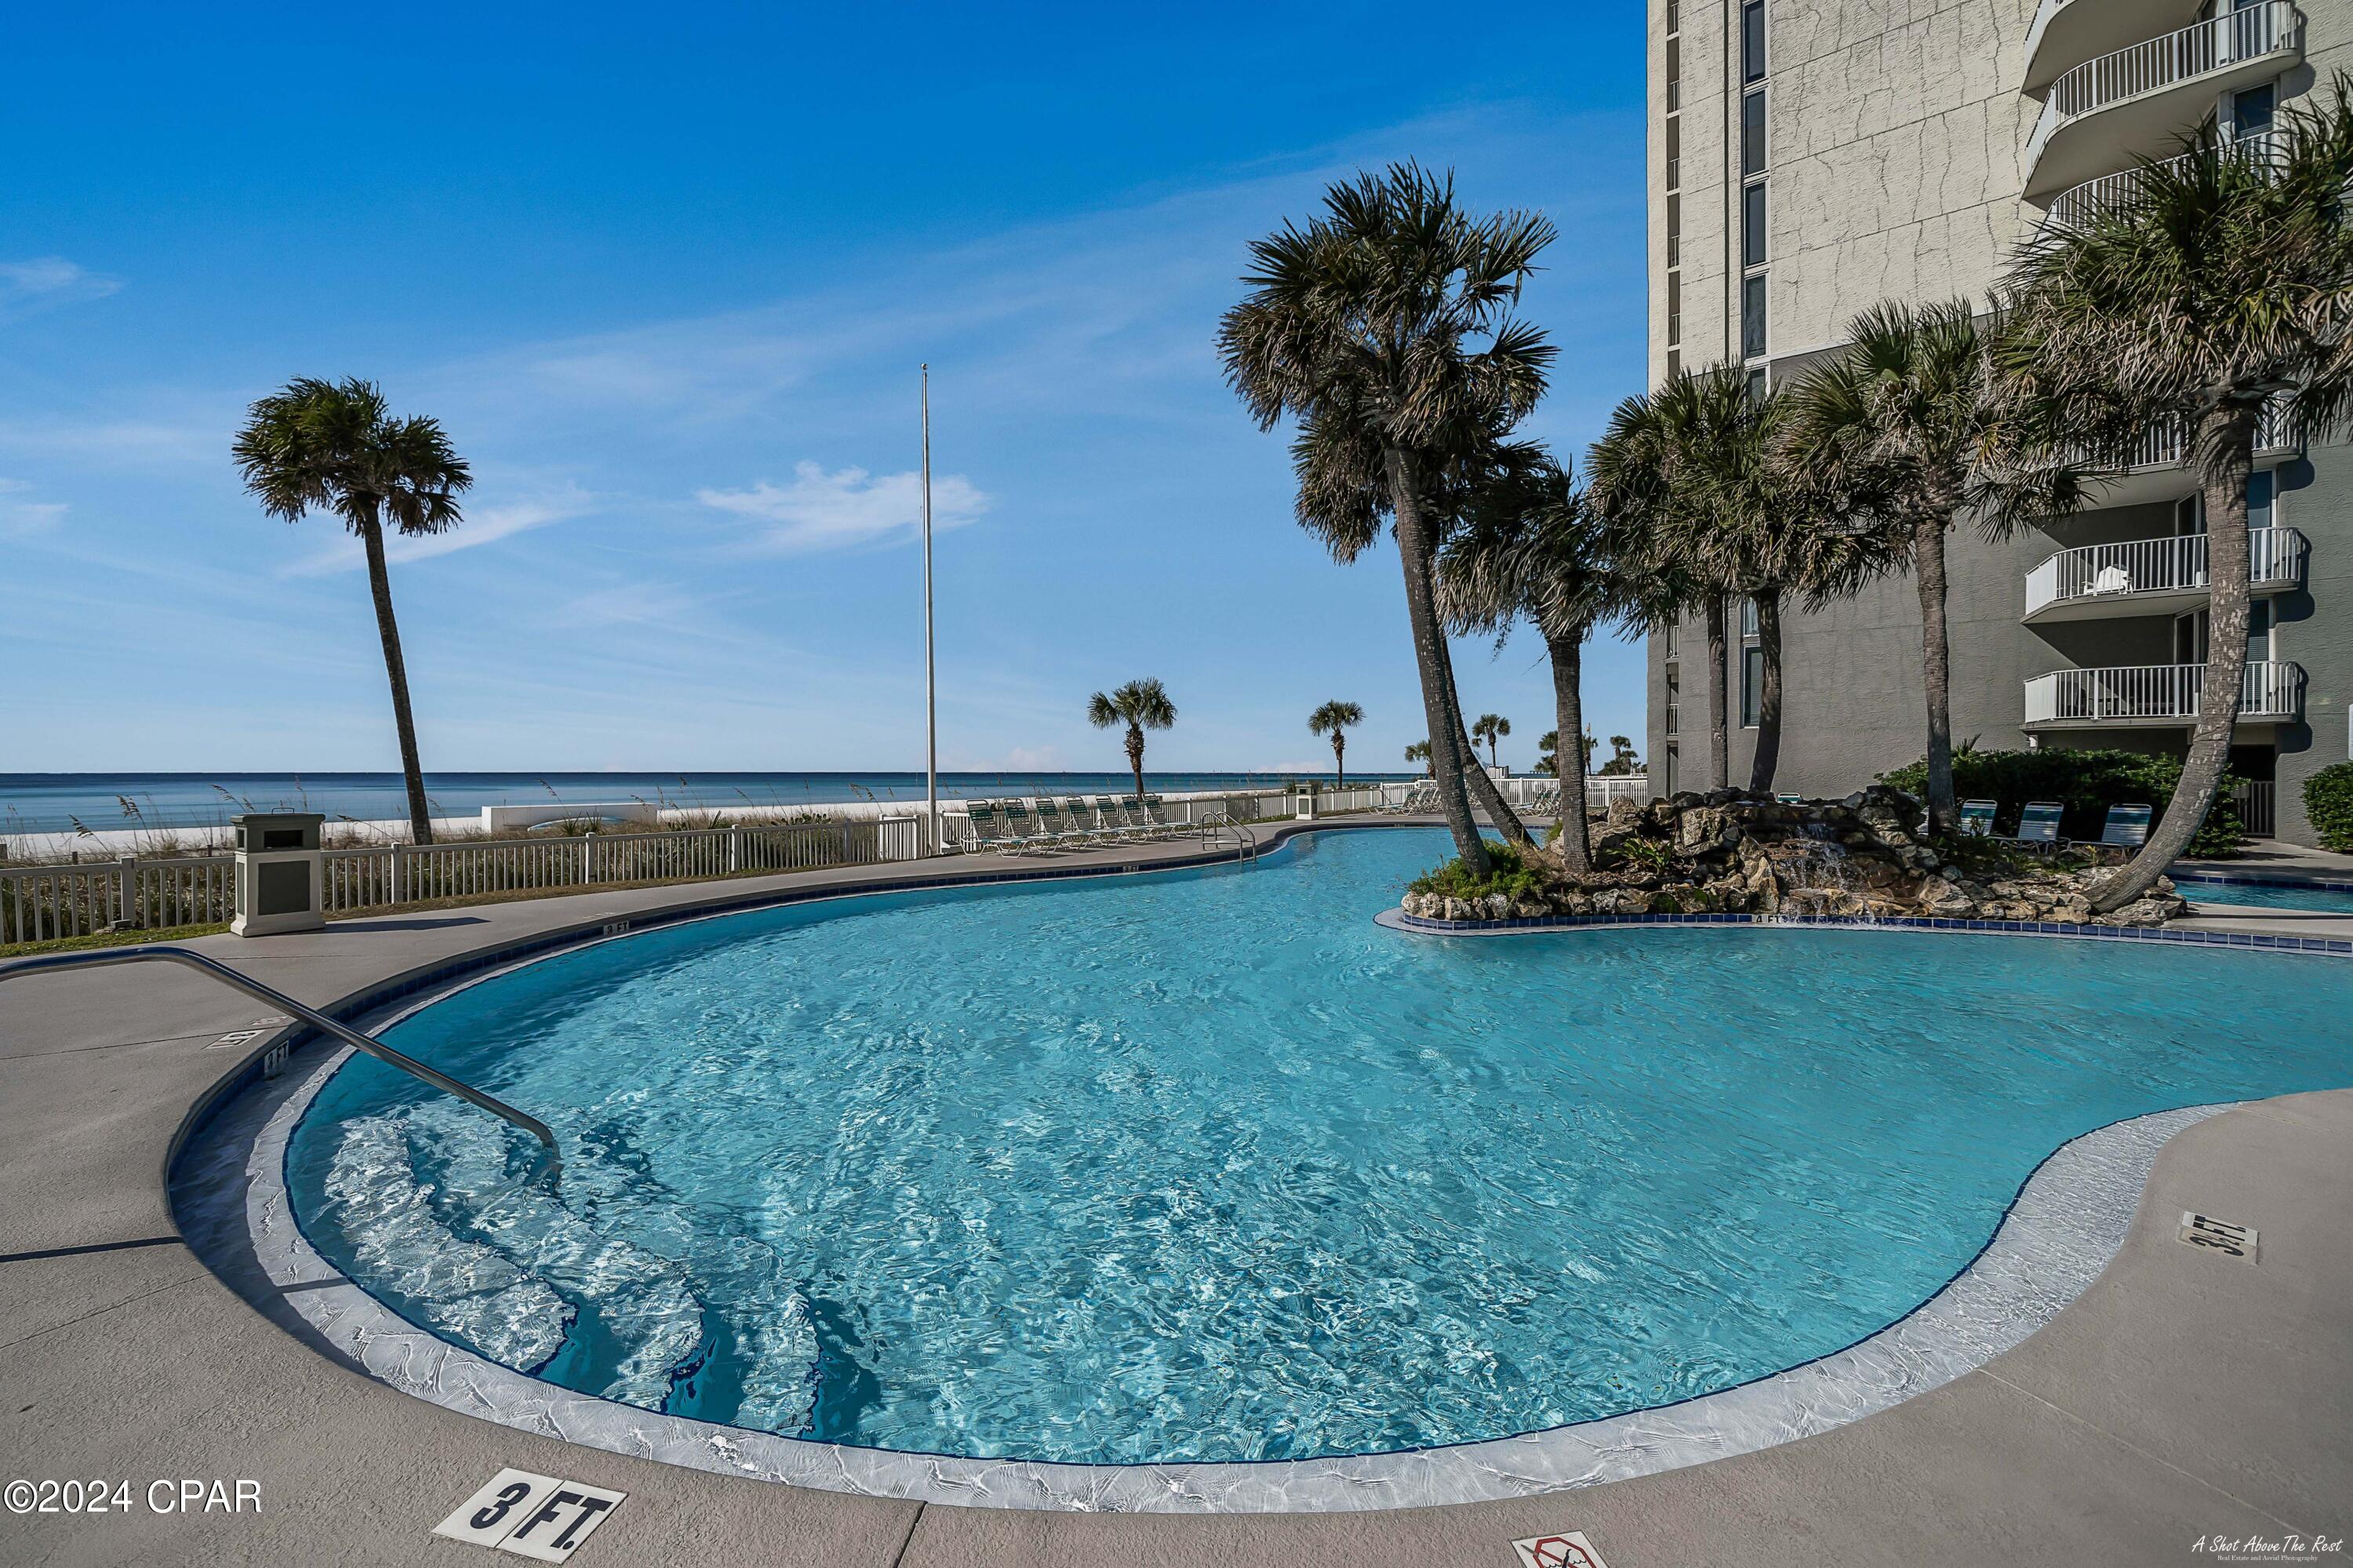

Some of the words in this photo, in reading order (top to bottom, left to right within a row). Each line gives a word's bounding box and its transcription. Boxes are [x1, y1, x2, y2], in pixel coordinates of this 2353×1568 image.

[616, 922, 628, 932] FT
[1756, 915, 1763, 923] 4
[267, 1052, 274, 1070] 3
[276, 1042, 288, 1064] FT
[470, 1483, 531, 1530] 3
[513, 1490, 614, 1550] FT.
